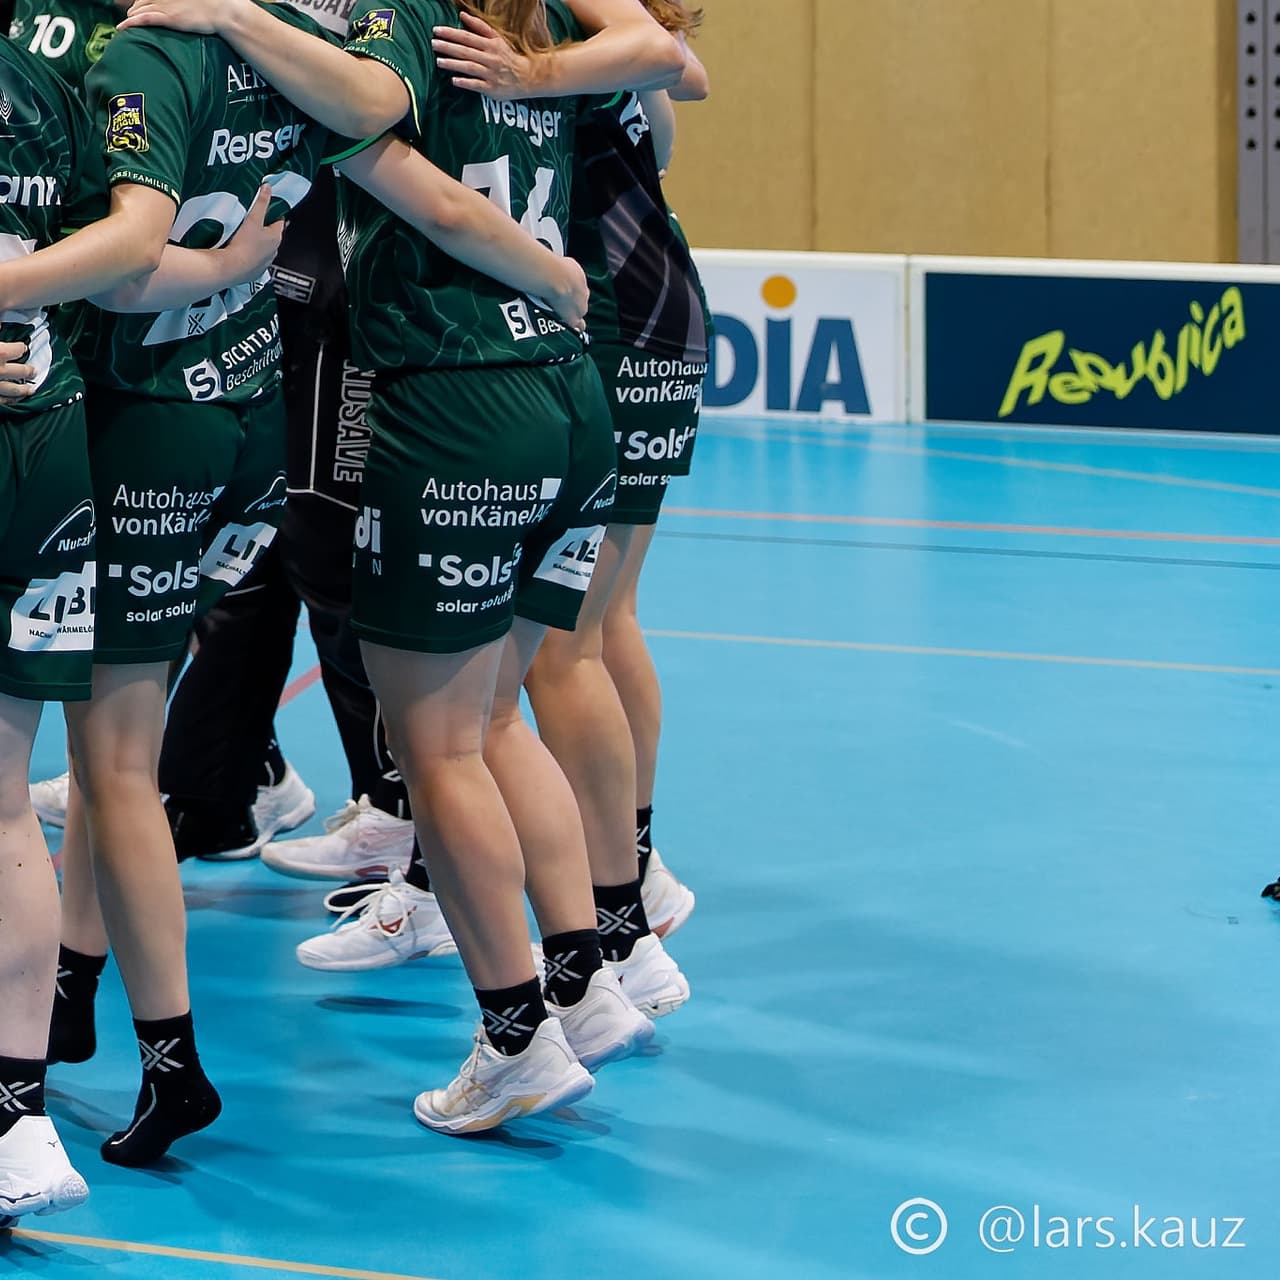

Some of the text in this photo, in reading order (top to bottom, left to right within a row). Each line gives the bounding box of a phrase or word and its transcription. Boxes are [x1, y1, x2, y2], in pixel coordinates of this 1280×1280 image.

[28, 14, 75, 59] 10
[207, 123, 307, 167] Reiser
[422, 477, 538, 502] Autohaus
[619, 472, 659, 486] solar
[127, 560, 199, 597] Sols
[126, 608, 164, 622] solar
[436, 599, 479, 613] solar
